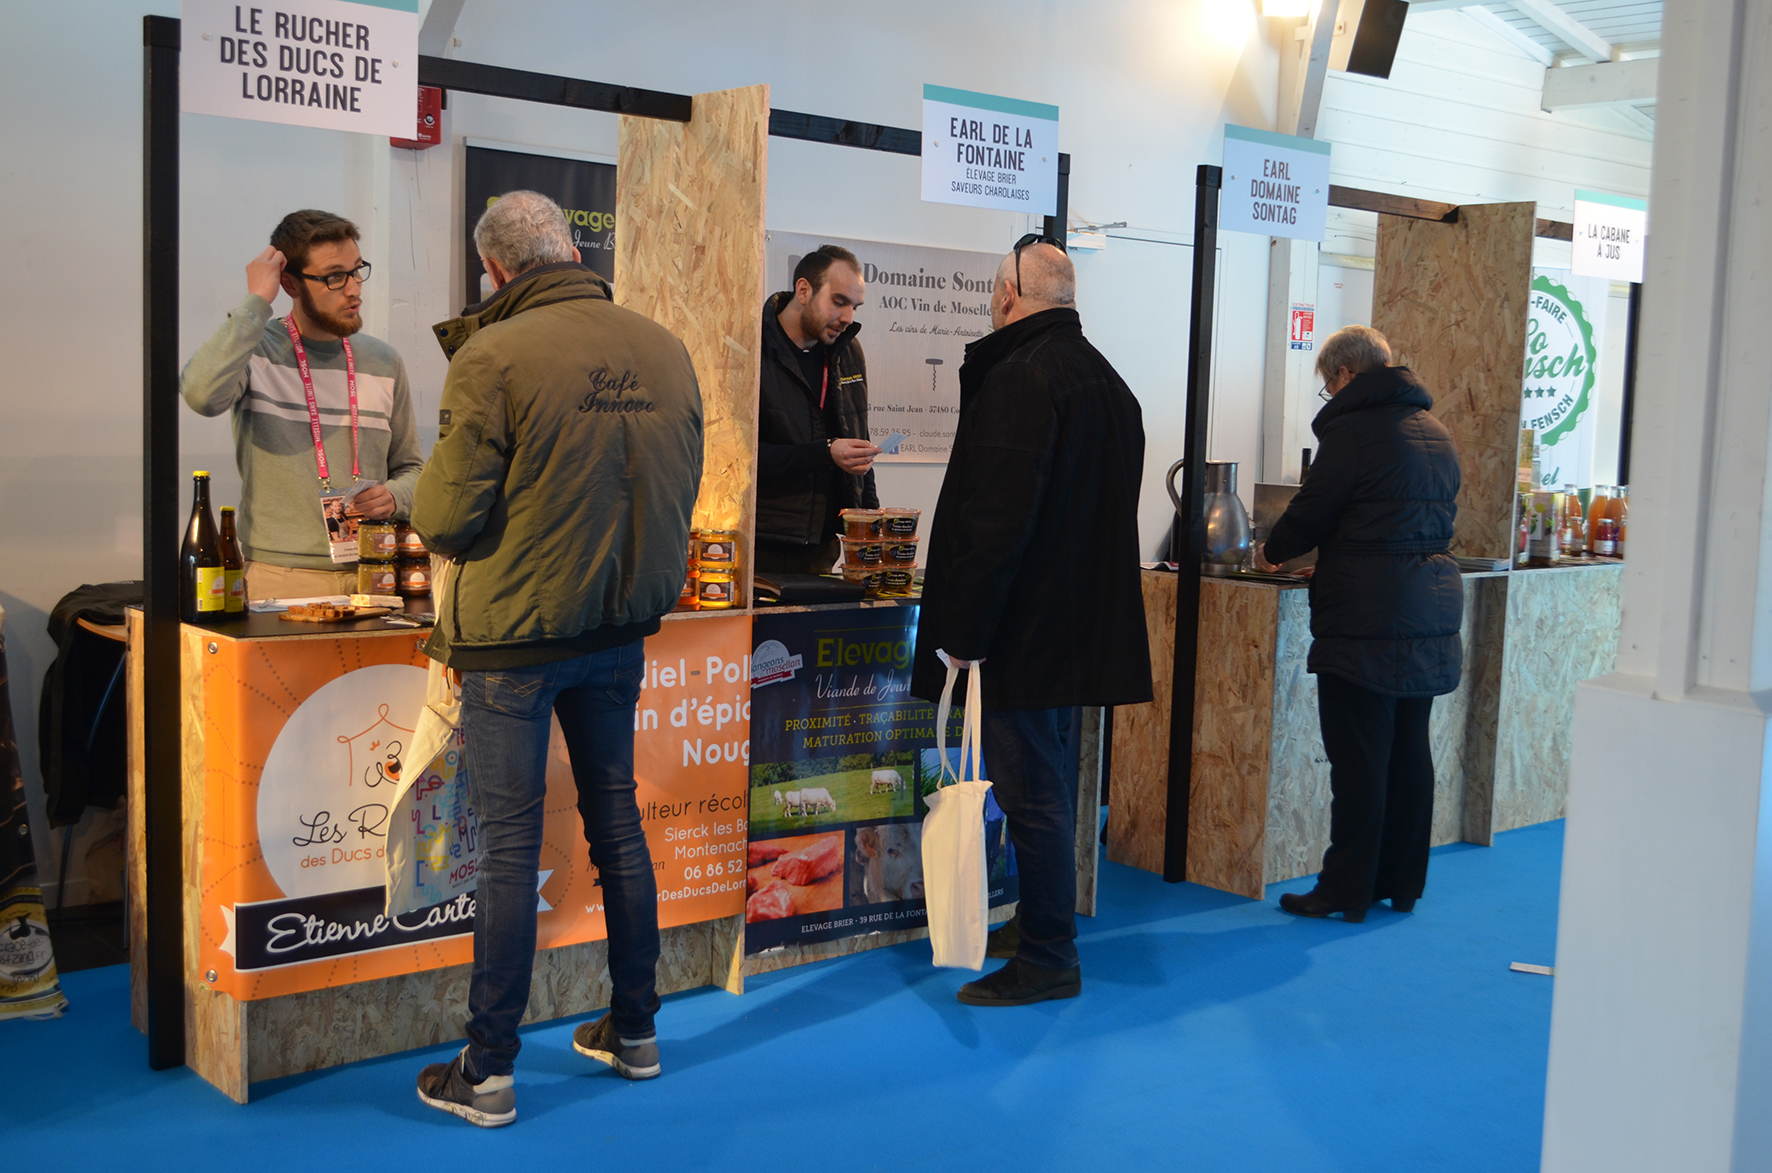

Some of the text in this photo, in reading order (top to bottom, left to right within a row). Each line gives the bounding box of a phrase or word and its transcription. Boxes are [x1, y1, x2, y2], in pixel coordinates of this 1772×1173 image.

[236, 5, 370, 51] LE RUCHER
[220, 36, 382, 84] DES DUCS DE
[242, 72, 362, 113] LORRAINE
[950, 117, 1032, 149] EARL DE LA
[957, 143, 1025, 171] FONTAINE
[998, 172, 1016, 185] BRIER
[1264, 159, 1290, 180] EARL
[951, 181, 1030, 200] SAVEURS CHAROLAISES
[1250, 179, 1301, 204] DOMAINE
[564, 208, 615, 232] vage
[1252, 202, 1296, 225] SONTAG
[573, 229, 601, 248] Jeune
[1588, 224, 1630, 244] LA CABANE
[1605, 244, 1620, 260] JUS
[864, 262, 994, 294] Domaine Sont
[879, 295, 992, 316] AOC Vin de Moselle
[890, 322, 903, 332] Les
[920, 325, 928, 334] de
[588, 367, 640, 398] Café
[309, 401, 318, 416] SANS
[578, 392, 655, 413] Innovo
[886, 404, 906, 413] Saint
[906, 404, 923, 414] Jean
[1530, 394, 1574, 430] FENSCH
[900, 444, 916, 453] EARL
[918, 444, 948, 454] Domaine
[1541, 466, 1560, 486] el
[815, 638, 911, 670] Elevag
[766, 658, 801, 674] mosellan
[815, 669, 911, 701] Viande de Jeun
[785, 714, 851, 731] PROXIMITÉ
[859, 706, 934, 726] TRAÇABILITÉ
[802, 730, 886, 748] MATURATION
[886, 726, 950, 741] OPTIMAE
[292, 811, 348, 846] Les
[664, 824, 709, 842] Sierck
[714, 822, 732, 836] les
[301, 854, 326, 868] des
[332, 848, 372, 864] Ducs
[674, 837, 748, 860] Montenach
[684, 859, 743, 880] 06 86 52
[266, 912, 390, 953] Etienne
[802, 920, 832, 934] ELEVAGE
[834, 918, 854, 928] BRIER
[860, 916, 868, 924] 39
[868, 914, 883, 922] RUE
[884, 912, 894, 920] DE
[895, 910, 904, 918] LA
